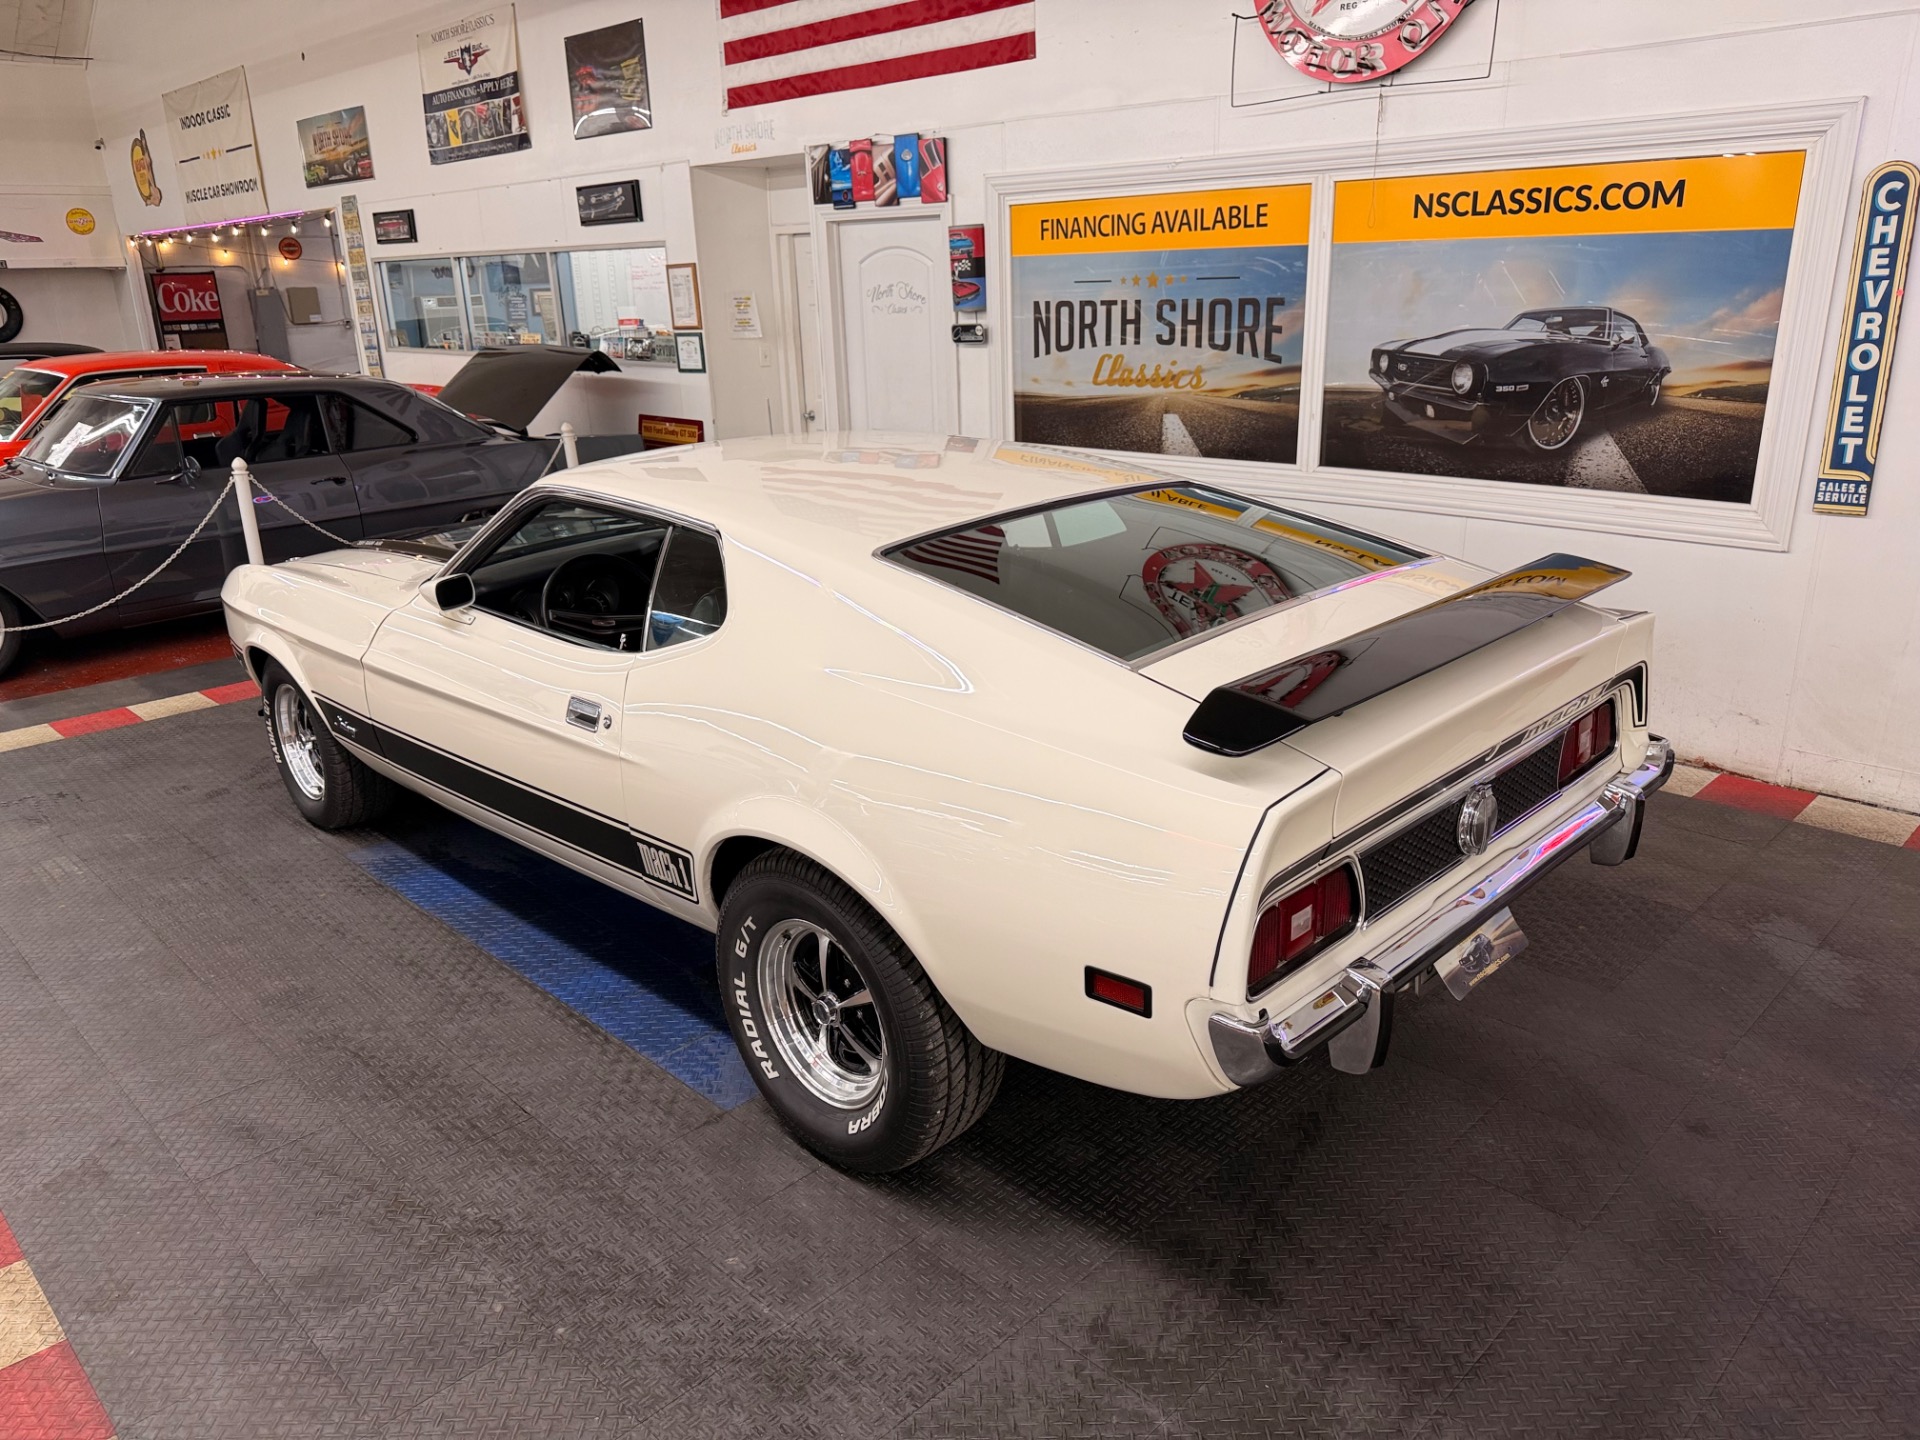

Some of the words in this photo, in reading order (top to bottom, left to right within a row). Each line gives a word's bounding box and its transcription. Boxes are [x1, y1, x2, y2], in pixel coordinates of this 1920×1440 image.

[1340, 2, 1358, 11] REG
[431, 28, 450, 43] NORTH
[447, 48, 460, 59] BEST
[432, 94, 447, 106] AUTO
[447, 85, 477, 102] FINANCING
[480, 80, 500, 94] APPLY
[500, 76, 514, 89] HERE
[179, 112, 206, 130] INDOOR
[206, 103, 231, 123] CLASSIC
[713, 124, 743, 150] NORTH
[745, 120, 775, 141] SHORE
[185, 188, 208, 204] MUSCLE
[208, 185, 221, 199] CAR
[220, 177, 258, 197] SHOWROOM
[1413, 179, 1686, 219] NSCLASSICS.COM
[1040, 212, 1146, 241] FINANCING
[1151, 203, 1269, 234] AVAILABLE
[157, 282, 220, 313] Coke
[1033, 299, 1141, 358] NORTH
[1156, 297, 1285, 364] SHORE
[1839, 180, 1905, 464] CHEVROLET
[1092, 353, 1207, 390] Classics
[1817, 491, 1867, 504] SERVICE
[1819, 481, 1856, 493] SALES
[1858, 484, 1868, 494] &
[265, 718, 283, 764] RADIAL
[678, 857, 692, 892] 1
[734, 916, 758, 959] G/T
[733, 972, 780, 1080] RADIAL
